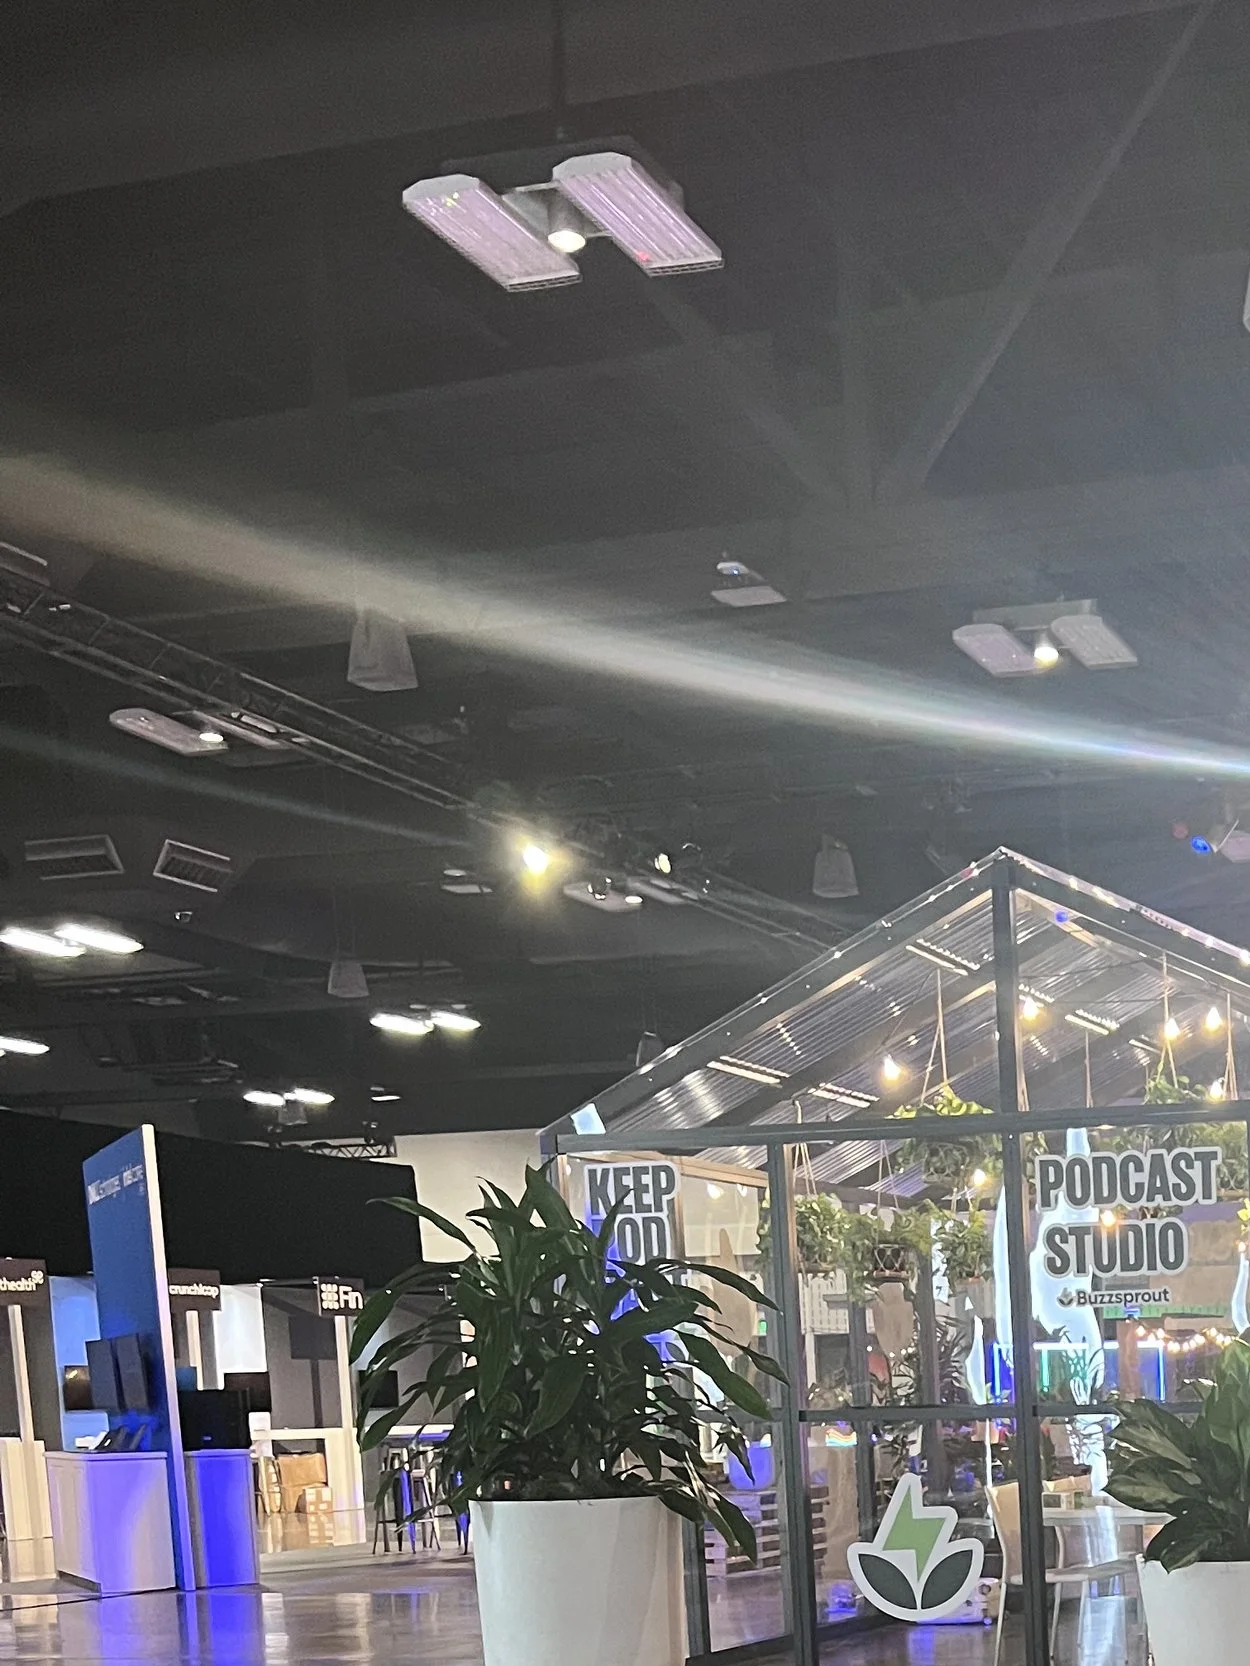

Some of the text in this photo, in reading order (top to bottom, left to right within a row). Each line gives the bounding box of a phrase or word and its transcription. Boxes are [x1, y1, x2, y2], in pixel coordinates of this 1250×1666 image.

[588, 1165, 675, 1216] KEEP
[1038, 1151, 1218, 1208] PODCAST
[1045, 1221, 1184, 1275] STUDIO
[1077, 1287, 1169, 1307] Buzzsprout
